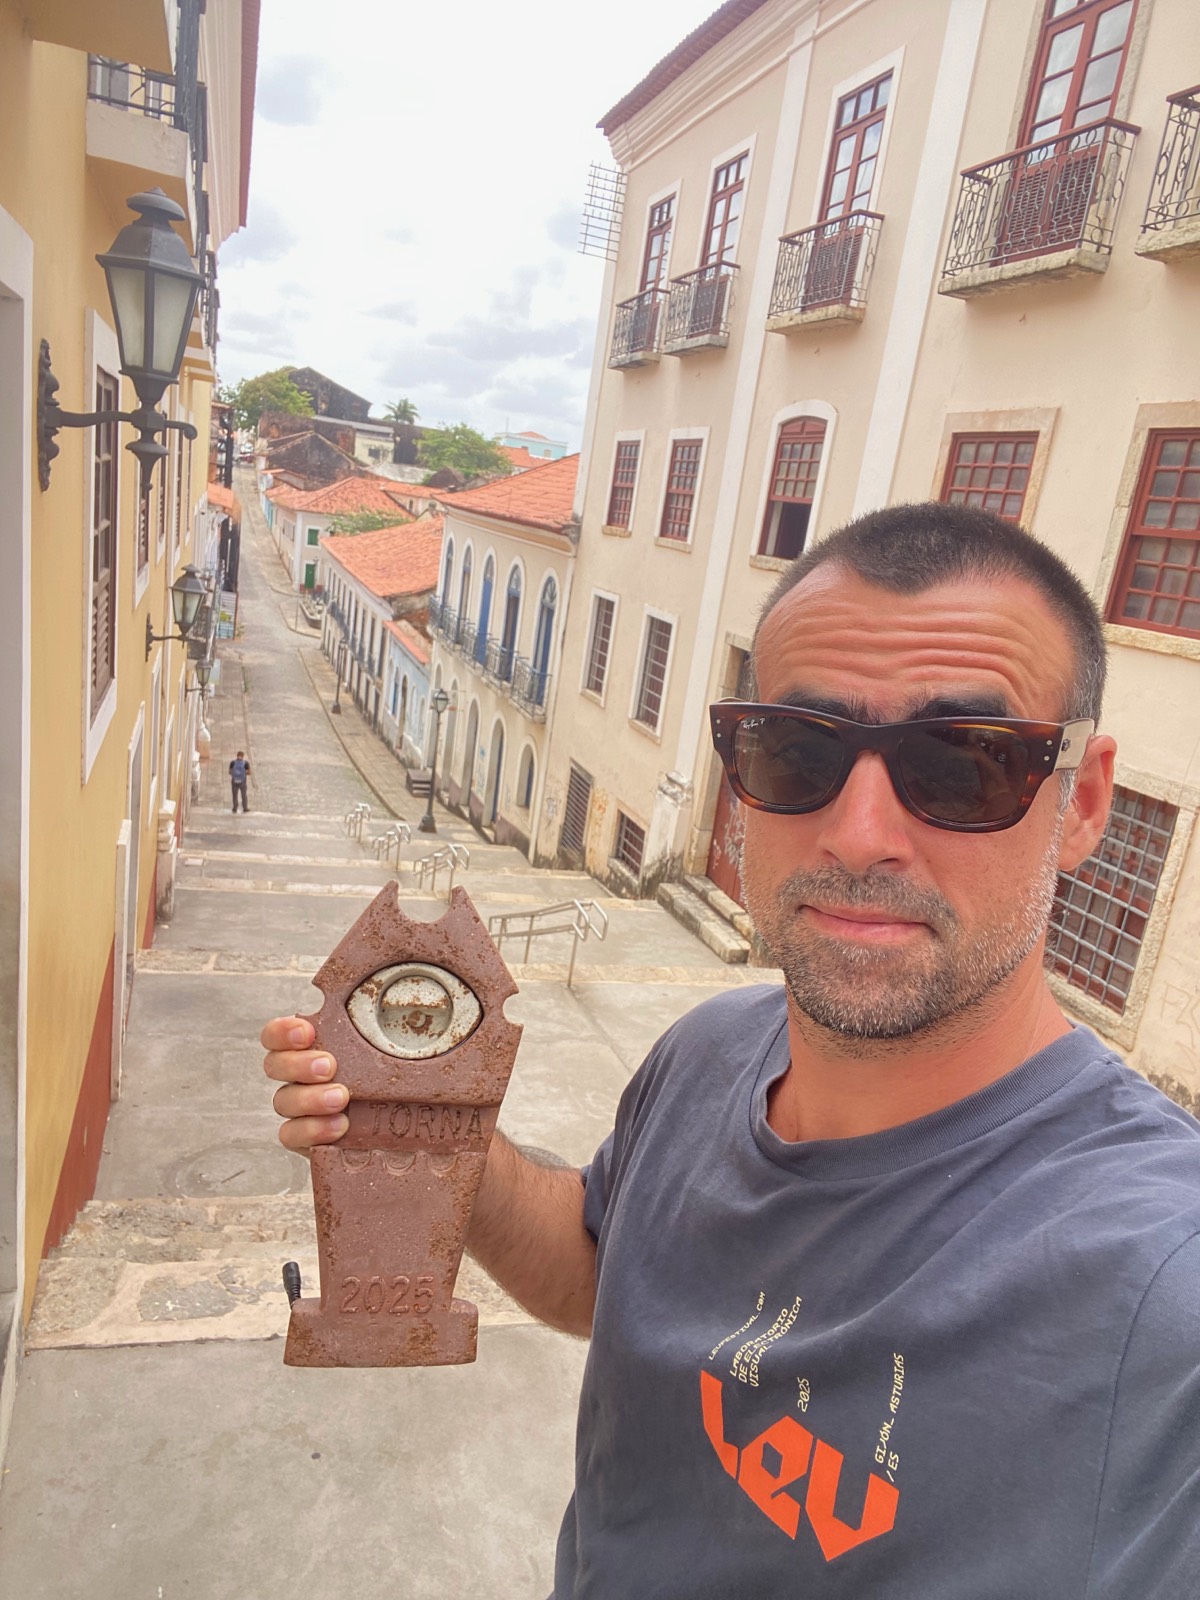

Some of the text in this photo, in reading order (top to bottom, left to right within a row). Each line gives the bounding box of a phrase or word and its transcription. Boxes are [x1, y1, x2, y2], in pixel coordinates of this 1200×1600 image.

[369, 1102, 484, 1140] TORNA
[340, 1275, 434, 1314] 2025
[729, 1308, 789, 1377] LABORATORIO
[738, 1295, 803, 1384] DE ELECTRÓNICA
[749, 1344, 773, 1388] VISUAL
[889, 1352, 905, 1414] ASTURIAS
[797, 1376, 811, 1413] 2025
